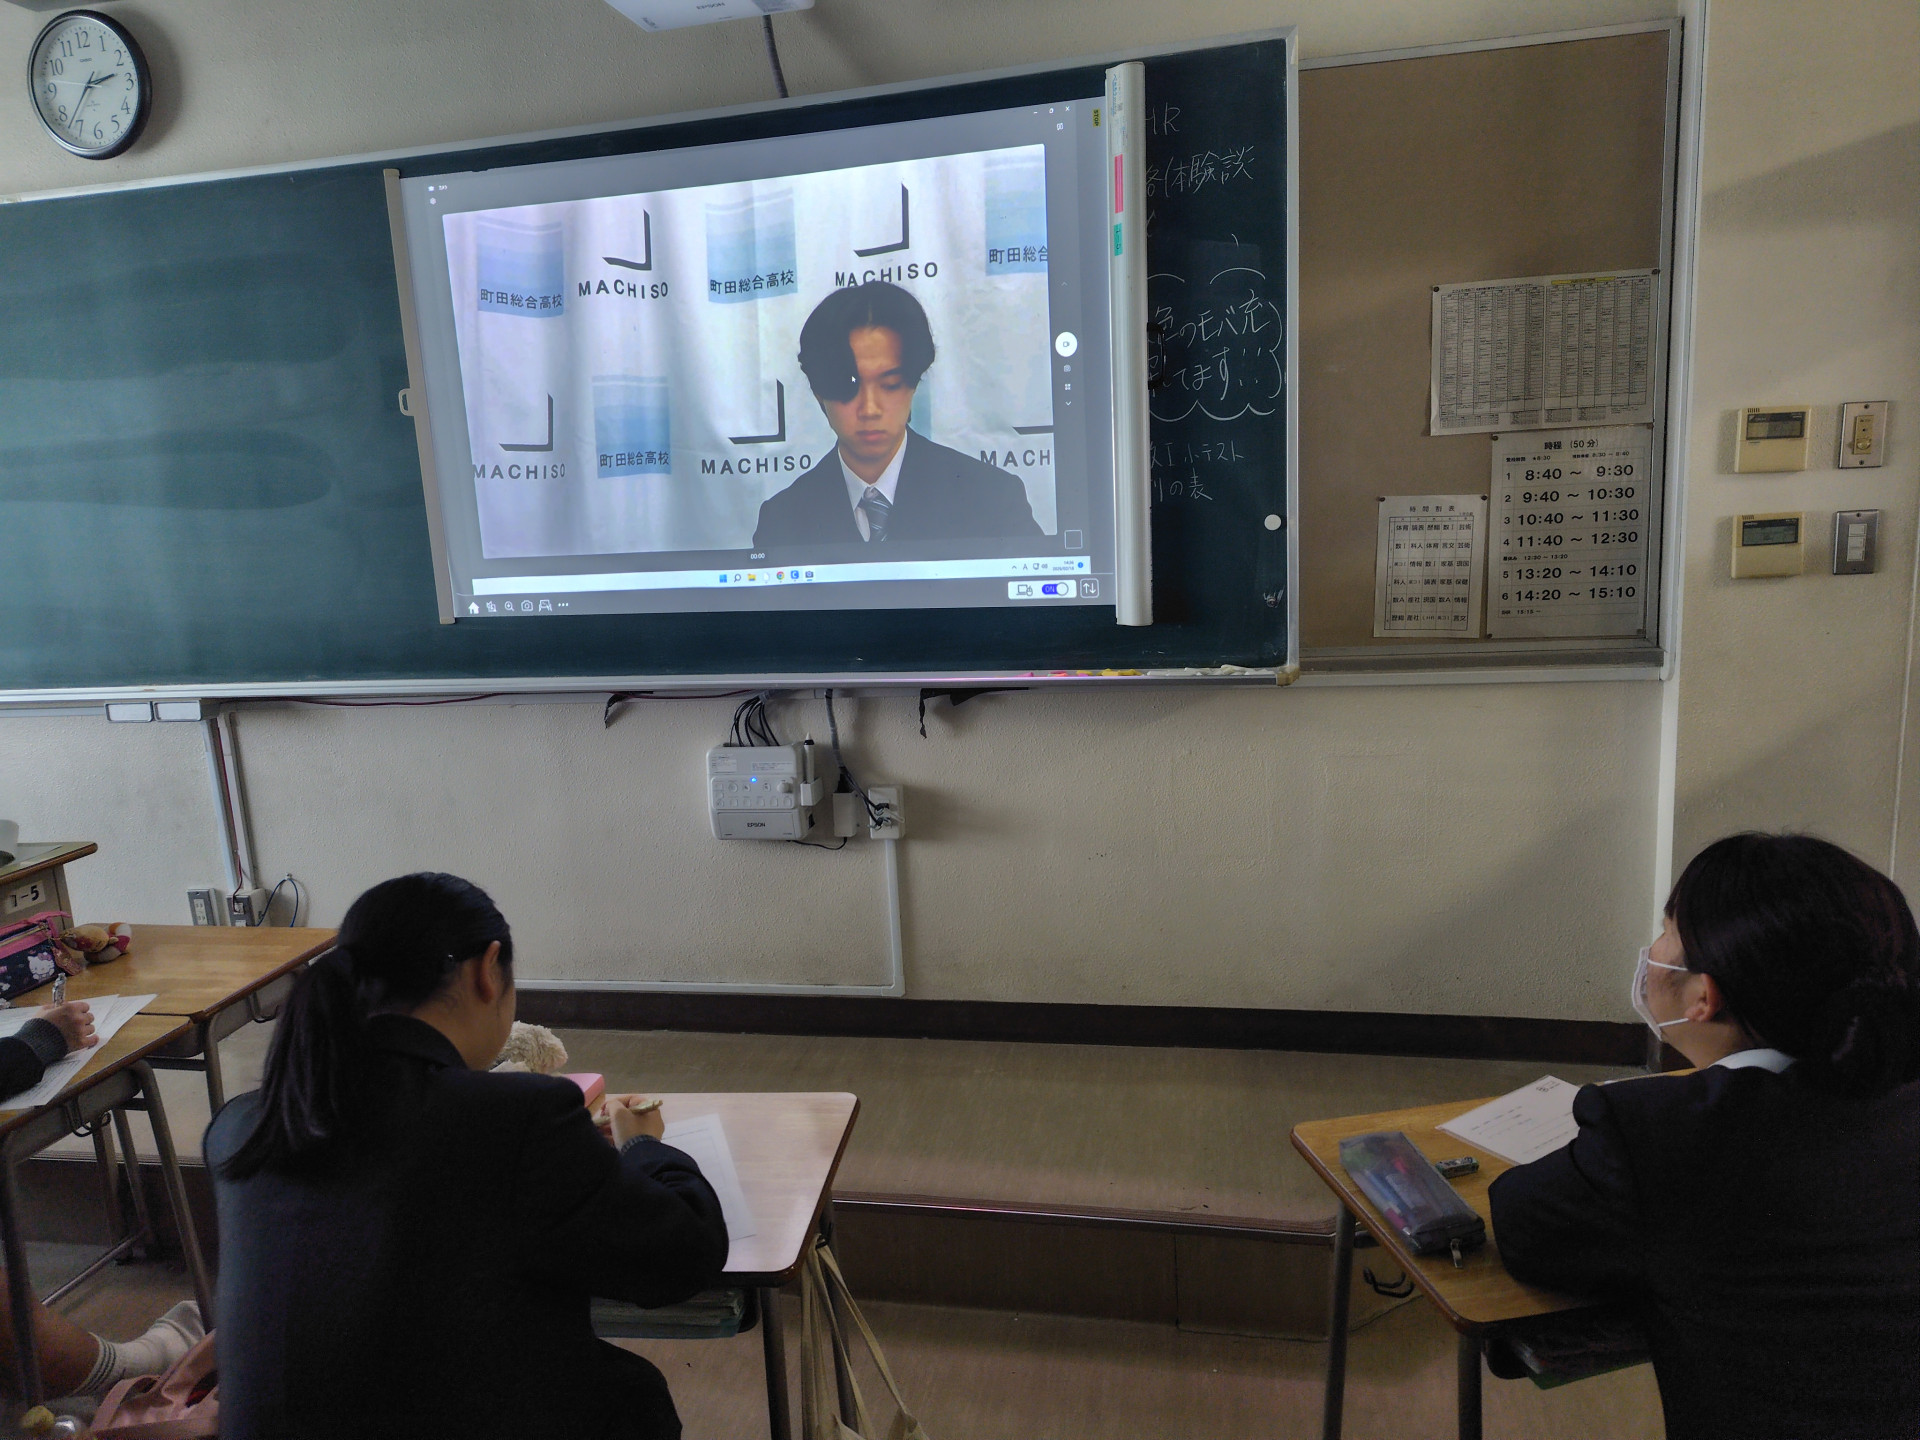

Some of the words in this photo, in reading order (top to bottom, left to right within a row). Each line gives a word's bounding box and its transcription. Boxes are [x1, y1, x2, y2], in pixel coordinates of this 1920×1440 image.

[60, 40, 74, 57] 11
[75, 30, 91, 49] 12
[99, 35, 106, 52] 1
[114, 49, 124, 66] 2
[50, 58, 64, 76] 10
[125, 72, 134, 91] 3
[48, 82, 57, 101] 9
[58, 104, 68, 123] 8
[120, 96, 130, 115] 4
[75, 119, 85, 138] 7
[93, 121, 104, 140] 6
[111, 114, 120, 134] 5
[709, 269, 795, 295] 町田総合高校
[835, 262, 938, 287] MACHISO
[578, 278, 669, 299] MACHISO
[480, 288, 563, 309] 町田総合高校
[600, 450, 670, 468] 町田総合高校
[701, 454, 812, 475] MACHISO
[472, 463, 566, 480] MACHISO
[1506, 472, 1511, 480] 1
[1525, 468, 1562, 481] 8:40
[1596, 464, 1634, 477] 9:30
[1504, 494, 1511, 502] 2
[1522, 490, 1560, 503] 9:40
[1588, 487, 1635, 500] 10:30
[1504, 516, 1511, 524] 3
[1518, 512, 1564, 526] 10:40
[1592, 509, 1639, 522] 11:30
[1503, 538, 1510, 546] 4
[1517, 535, 1563, 548] 11:40
[1591, 531, 1638, 544] 12:30
[1502, 570, 1509, 579] 5
[1516, 567, 1562, 580] 13:20
[1590, 564, 1637, 577] 14:10
[1045, 585, 1055, 593] ON
[1501, 592, 1508, 601] 6
[1515, 589, 1561, 602] 14:20
[1589, 586, 1636, 599] 15:10
